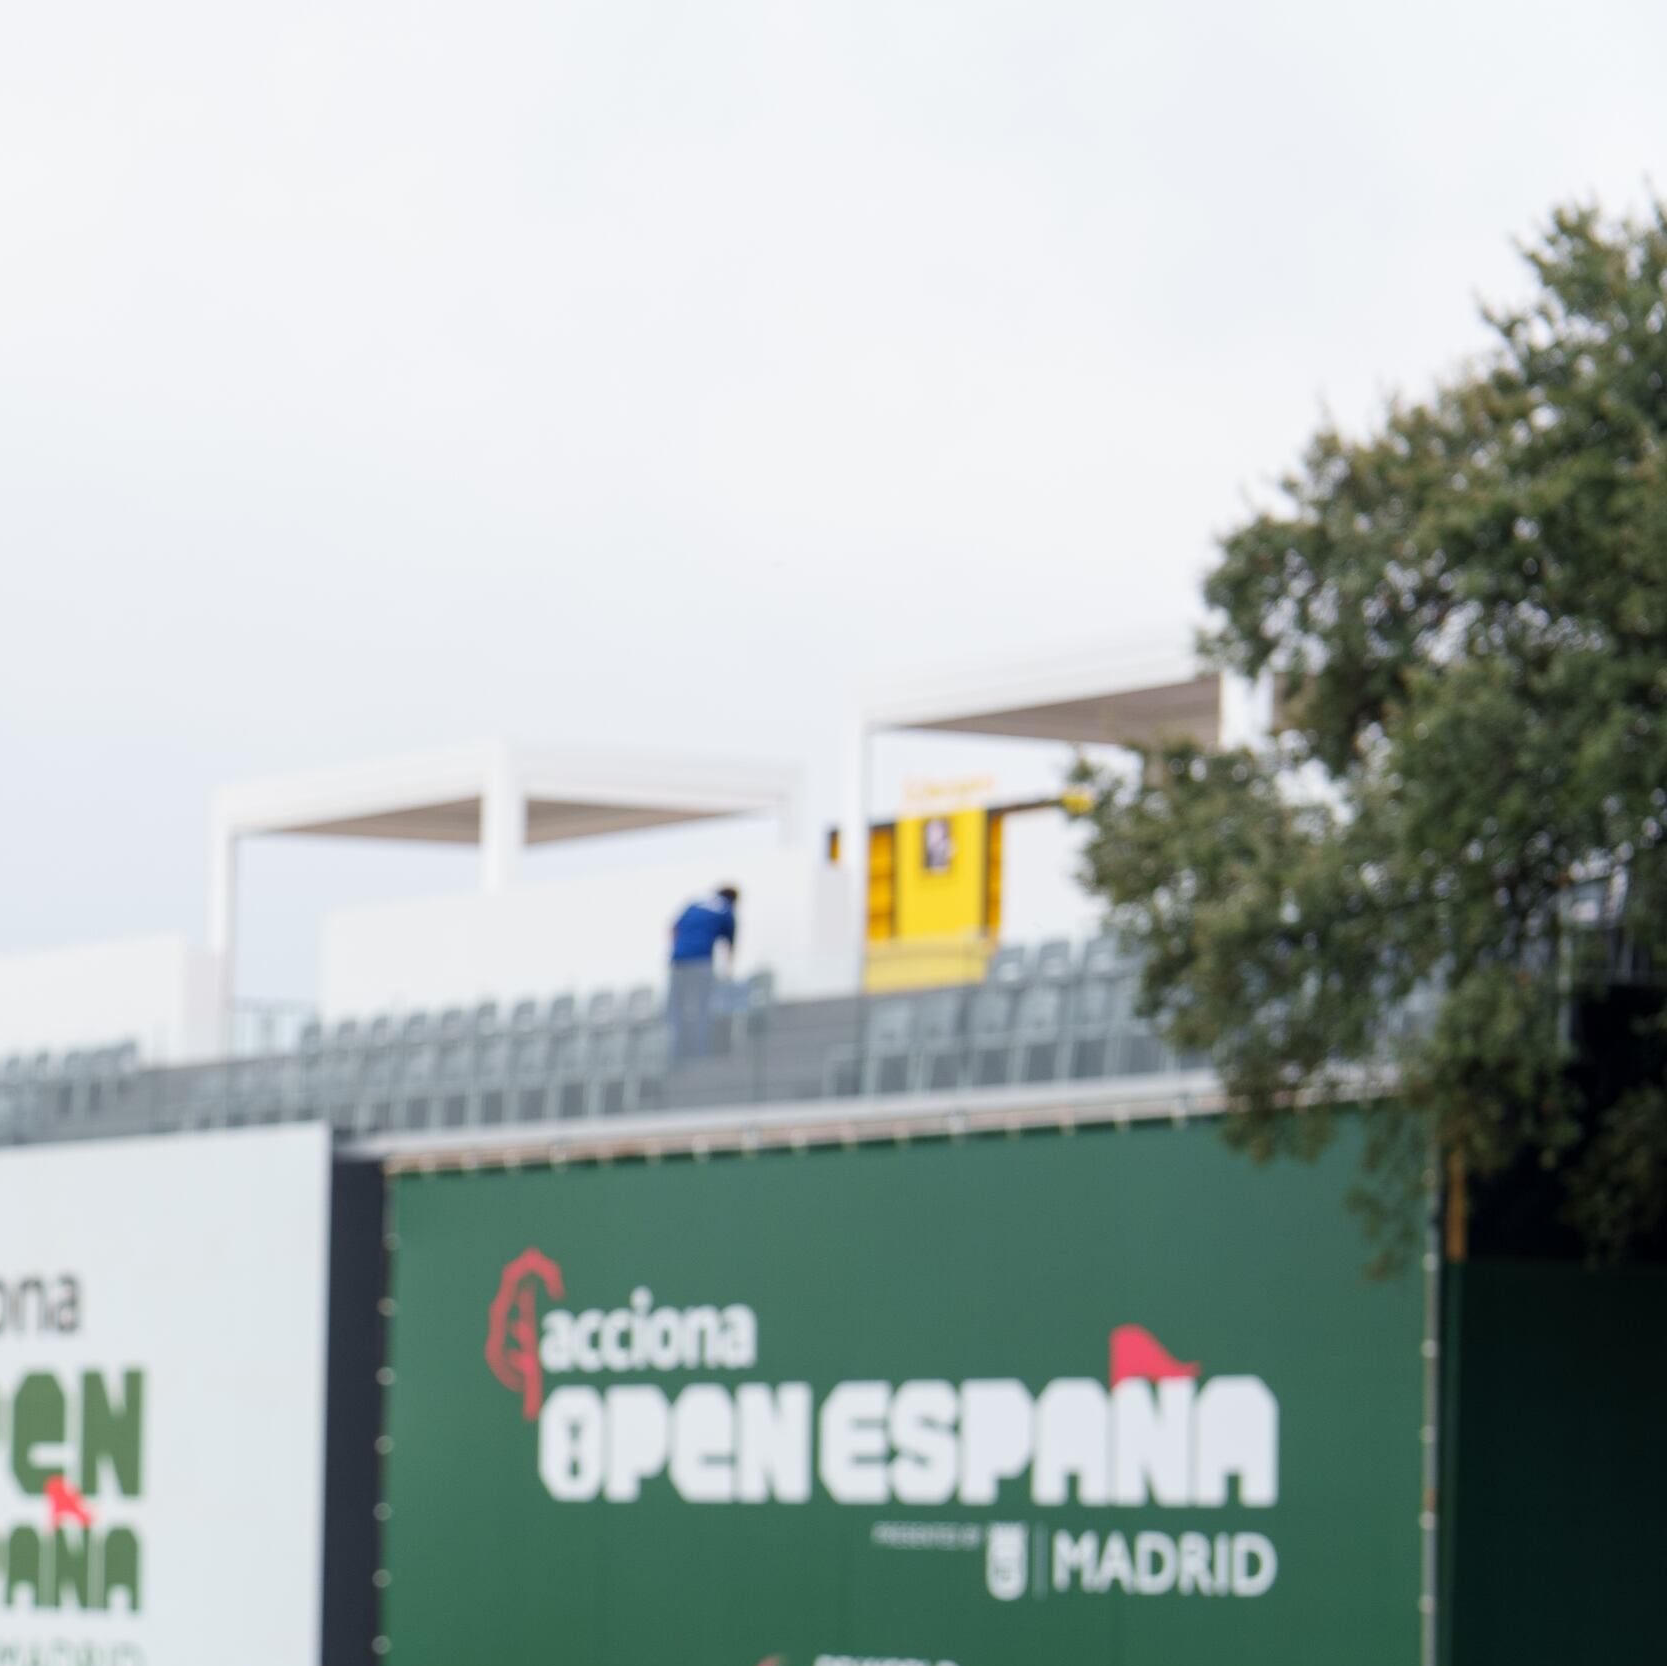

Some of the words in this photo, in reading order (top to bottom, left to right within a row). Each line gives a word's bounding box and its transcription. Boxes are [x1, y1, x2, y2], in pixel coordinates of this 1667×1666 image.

[540, 1287, 757, 1371] acciona
[539, 1382, 813, 1502] OPEN
[1053, 1530, 1279, 1598] MADRID
